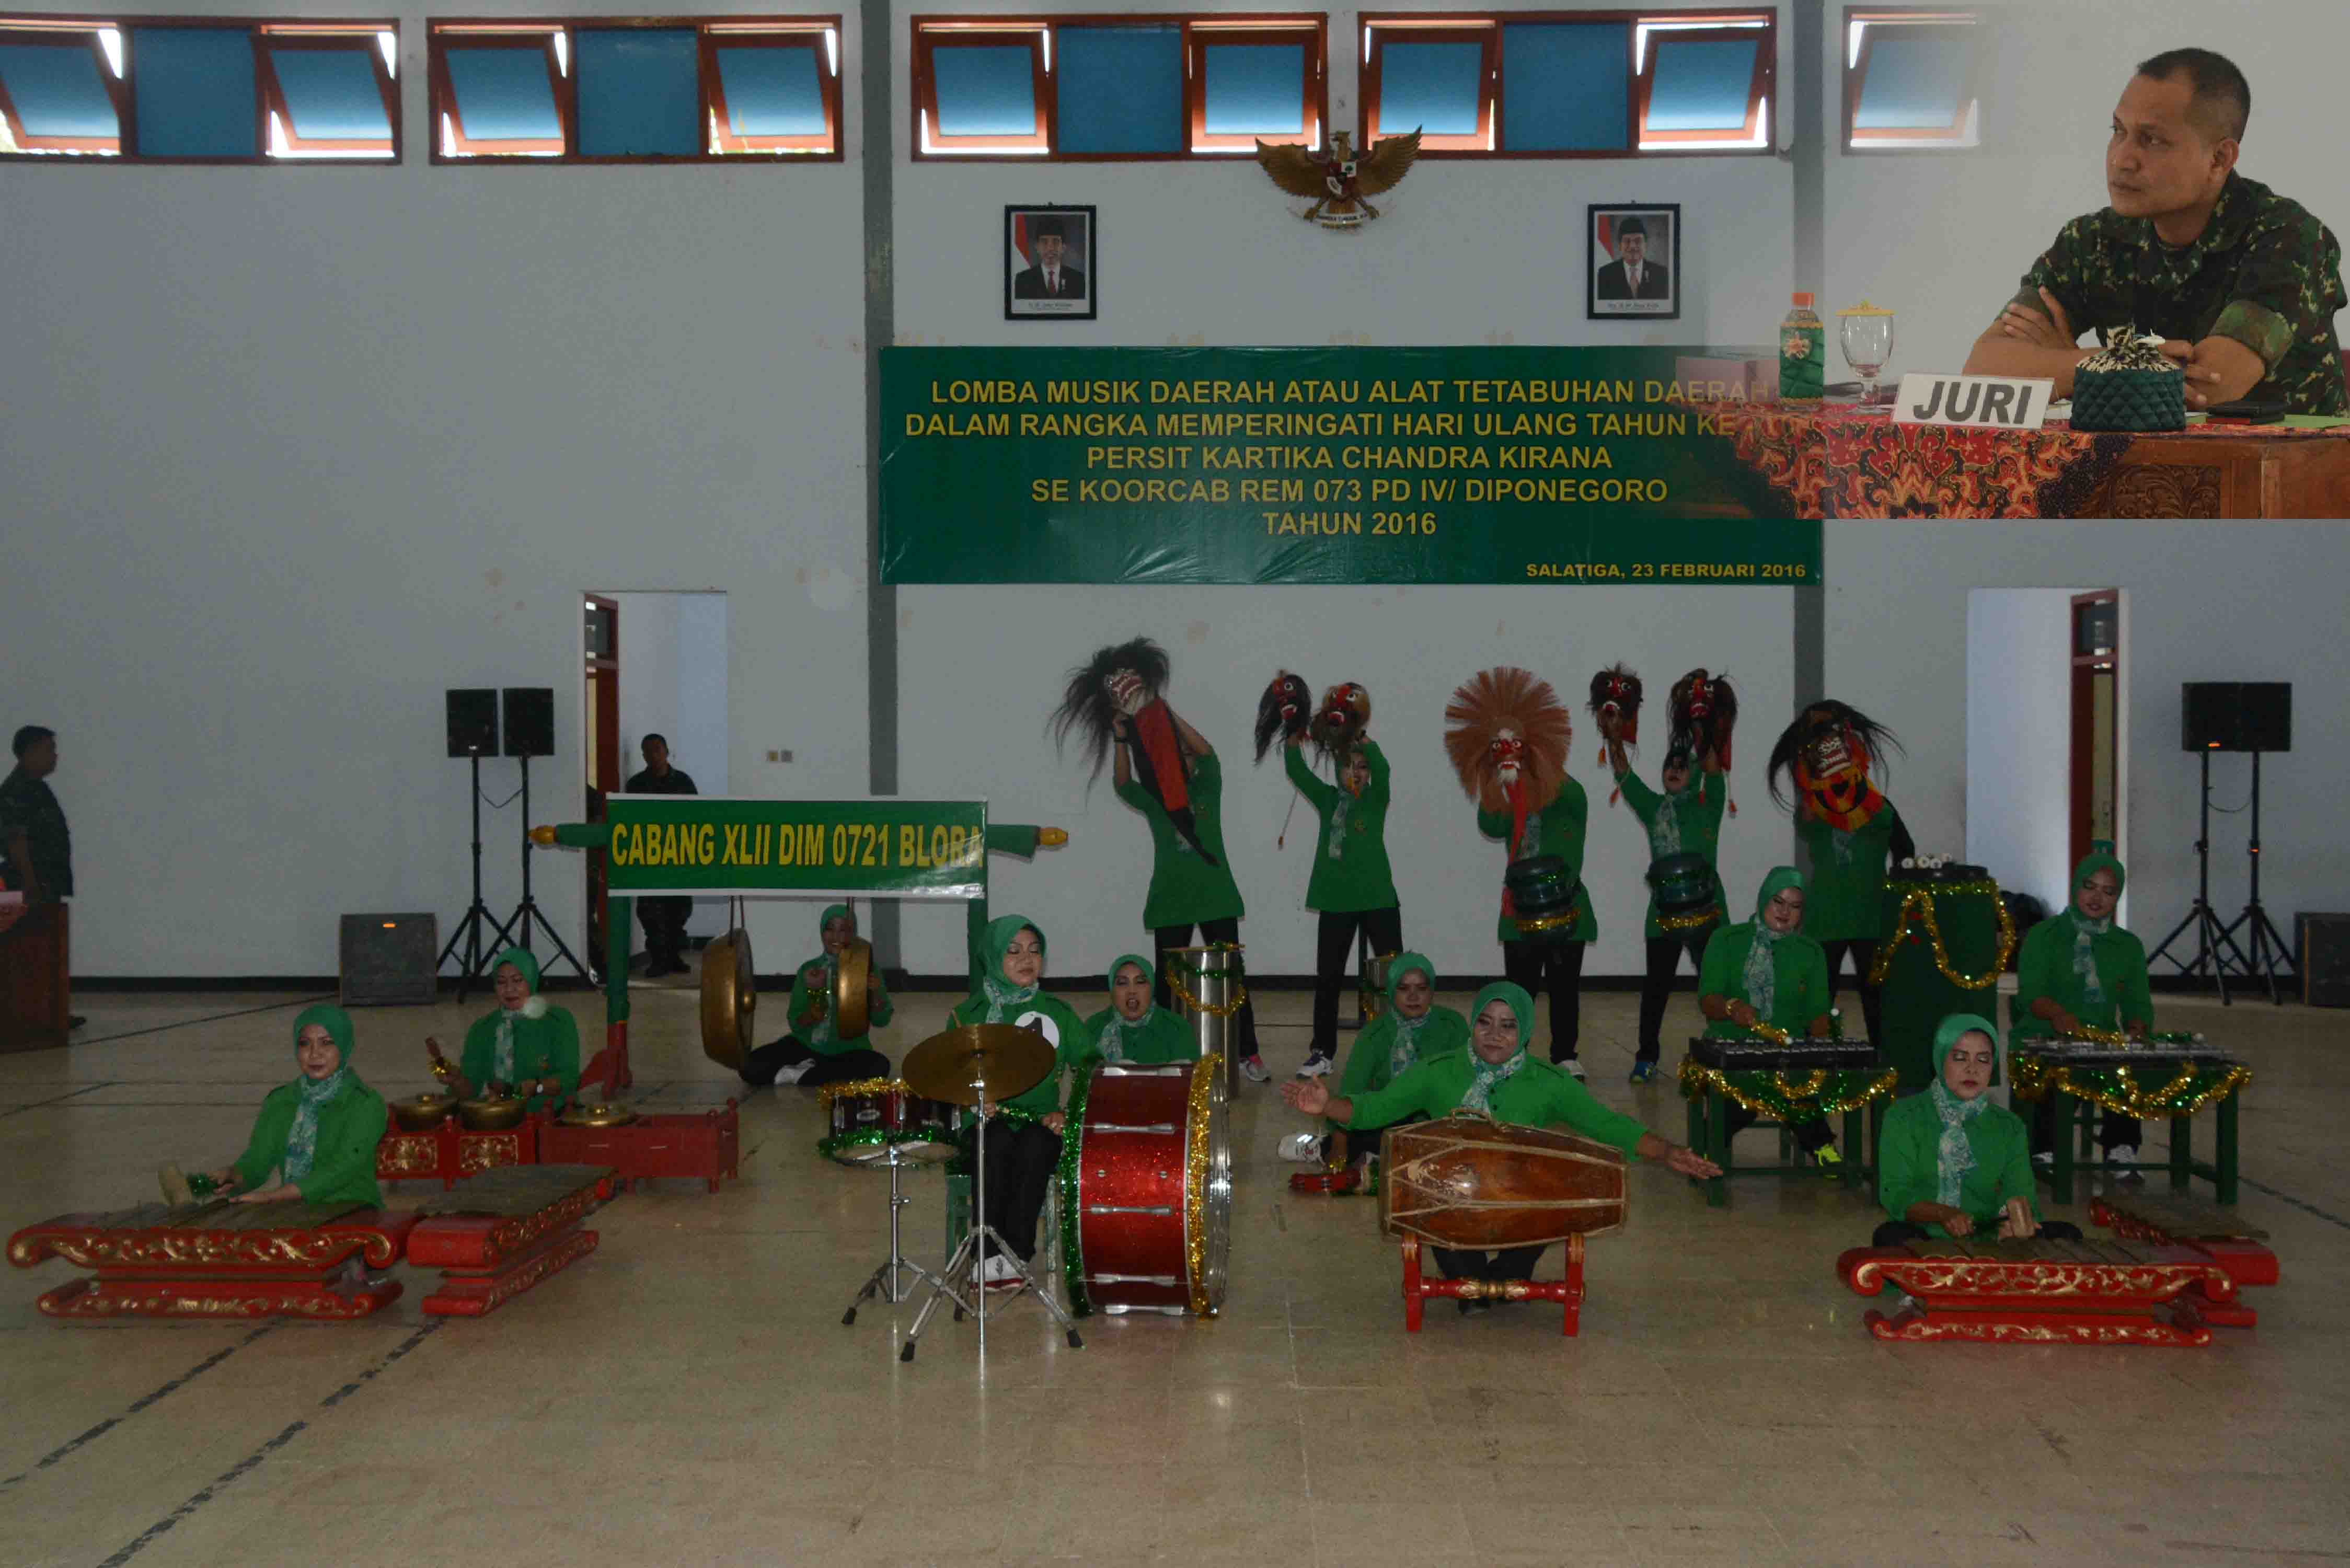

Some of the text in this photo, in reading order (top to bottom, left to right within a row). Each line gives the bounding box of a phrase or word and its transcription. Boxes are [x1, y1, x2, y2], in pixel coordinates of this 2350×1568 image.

[931, 380, 1768, 403] LOMBA MUSIK DAERAH ATAU ALAT TETABUHAN DAERAH
[1913, 381, 2032, 424] JURI
[905, 414, 1010, 435] DALAM
[1020, 414, 1148, 435] RANGKA
[1156, 414, 1382, 435] MEMPERINGATI
[1393, 414, 1463, 435] HARI
[1472, 414, 1576, 435] ULANG
[1586, 414, 1686, 435] TAHUN
[1088, 447, 1612, 469] PERSIT KARTIKA CHANDRA KIRANA
[1032, 480, 1668, 502] SE KOORCAB REM 073 PD IV/ DIPONEGORO
[1262, 513, 1436, 535] TAHUN 2016
[1526, 564, 1806, 578] SALATIGA, 23 FEBRUARI 2016
[612, 824, 983, 867] CABANG XLII DIM 0721 BLORA
